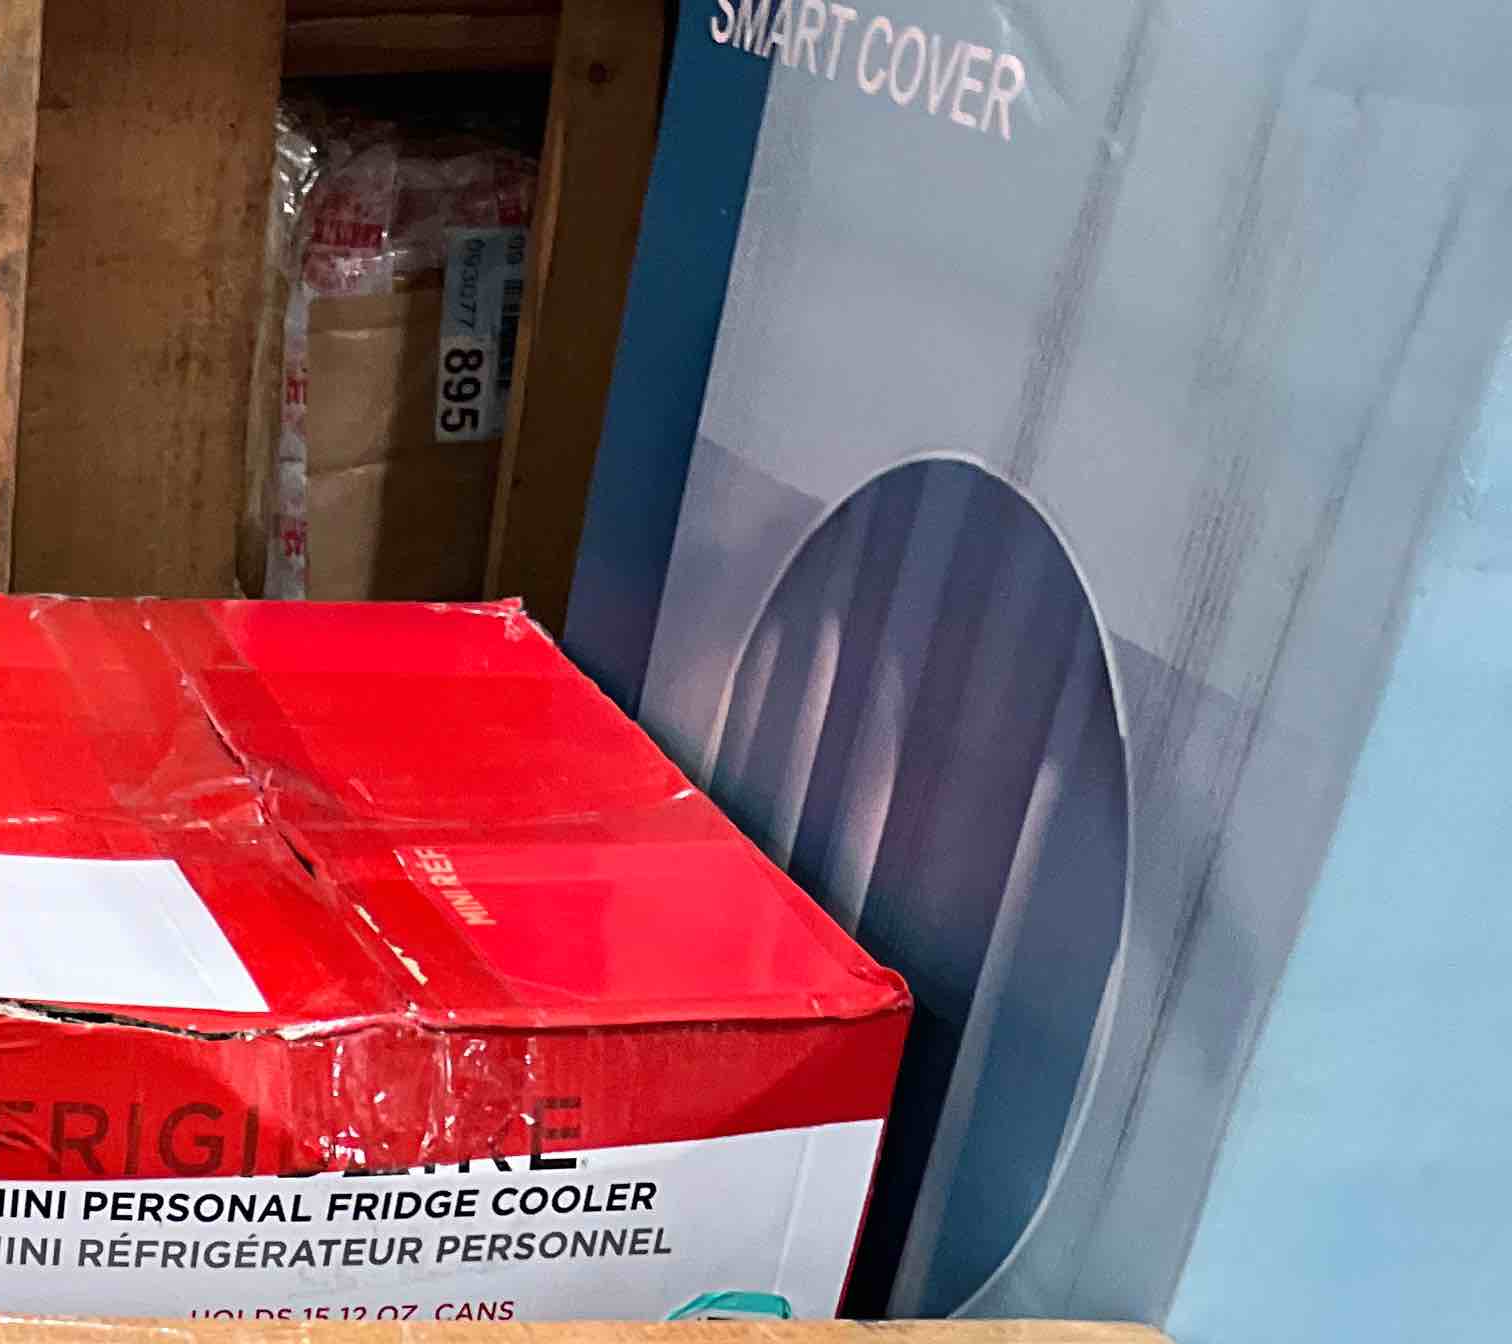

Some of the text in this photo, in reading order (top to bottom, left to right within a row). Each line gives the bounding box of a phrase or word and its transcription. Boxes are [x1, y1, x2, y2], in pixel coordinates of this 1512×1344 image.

[710, 0, 1028, 140] SMART COVER
[441, 347, 484, 433] 895
[440, 889, 497, 926] MINI
[82, 1191, 312, 1223] PERSONAL
[326, 1189, 480, 1222] FRIDGE
[491, 1182, 657, 1217] COOLER
[77, 1232, 423, 1269] RÉFRIGÉRATEUR
[435, 1227, 672, 1263] PERSONNEL
[434, 1301, 515, 1320] CANS
